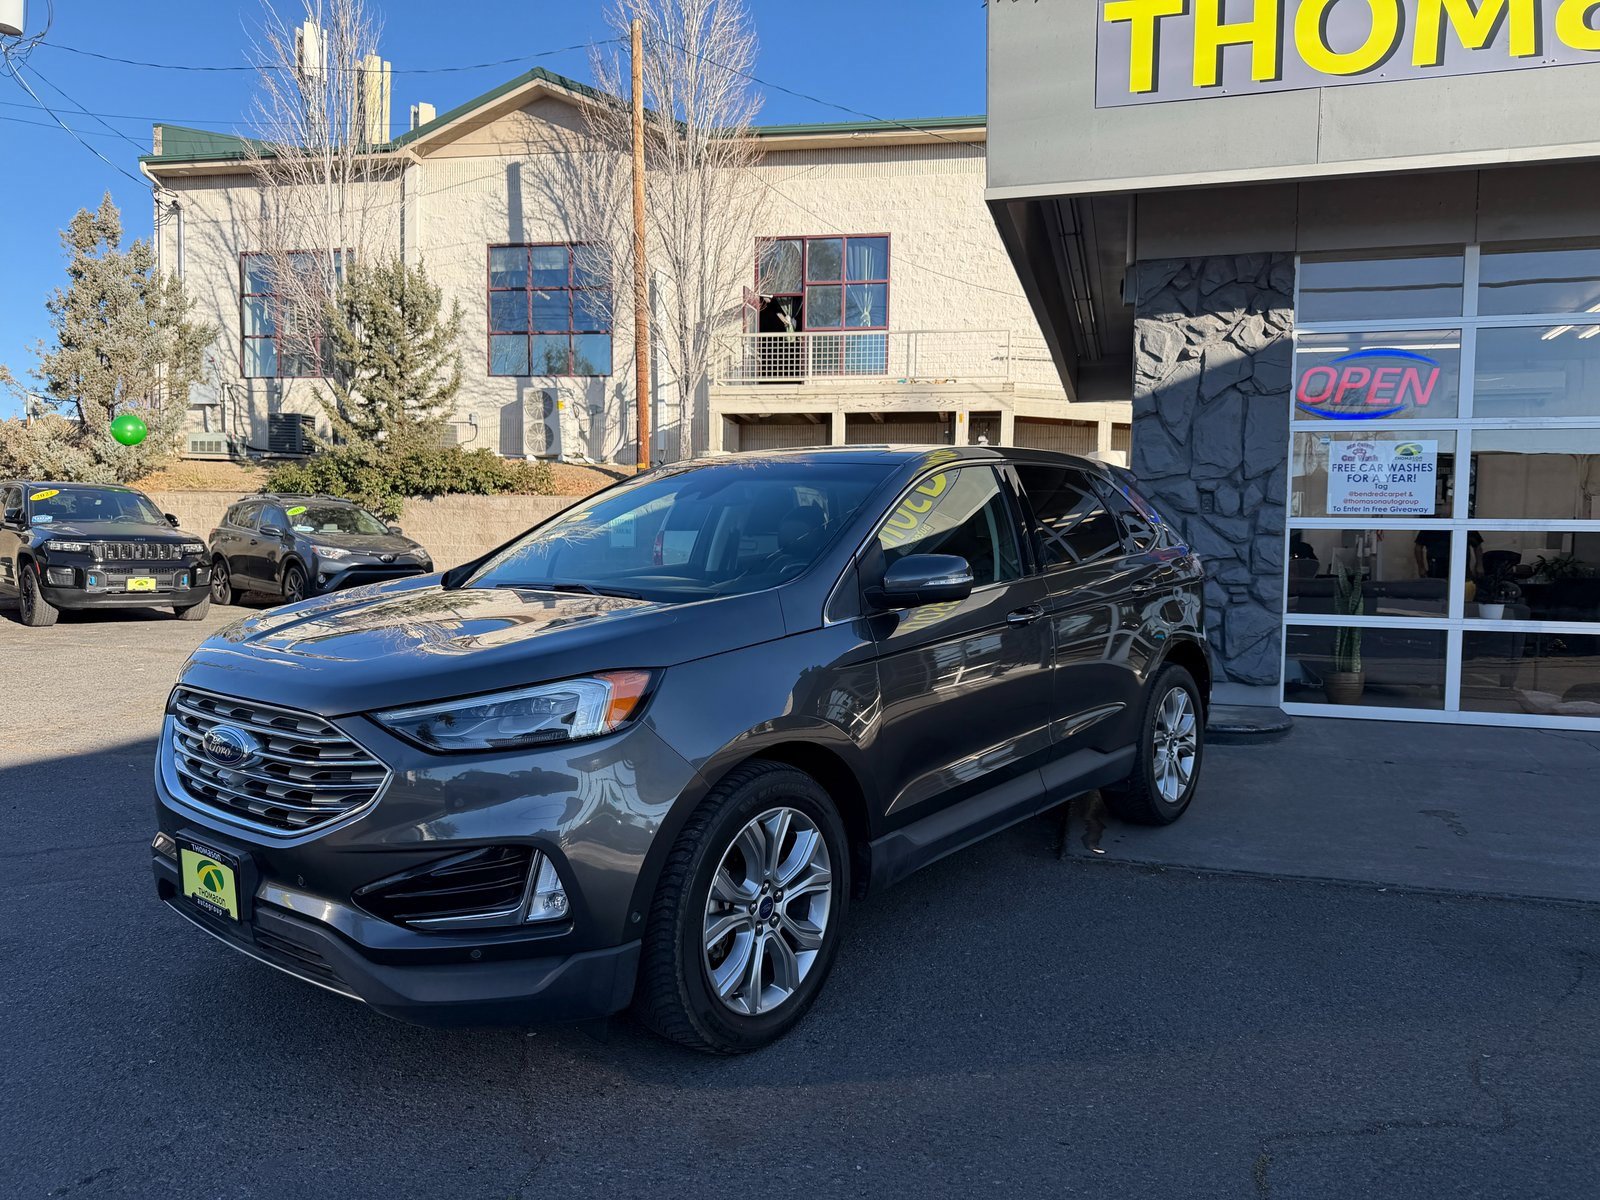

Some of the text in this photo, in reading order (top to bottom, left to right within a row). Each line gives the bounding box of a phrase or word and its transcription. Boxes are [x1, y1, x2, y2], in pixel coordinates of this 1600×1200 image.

[1296, 366, 1440, 405] OPEN
[1332, 464, 1433, 472] FREE CAR WASHES
[1347, 474, 1416, 482] FOR A YEAR!
[1375, 483, 1388, 491] Tag
[197, 898, 222, 916] autogroup
